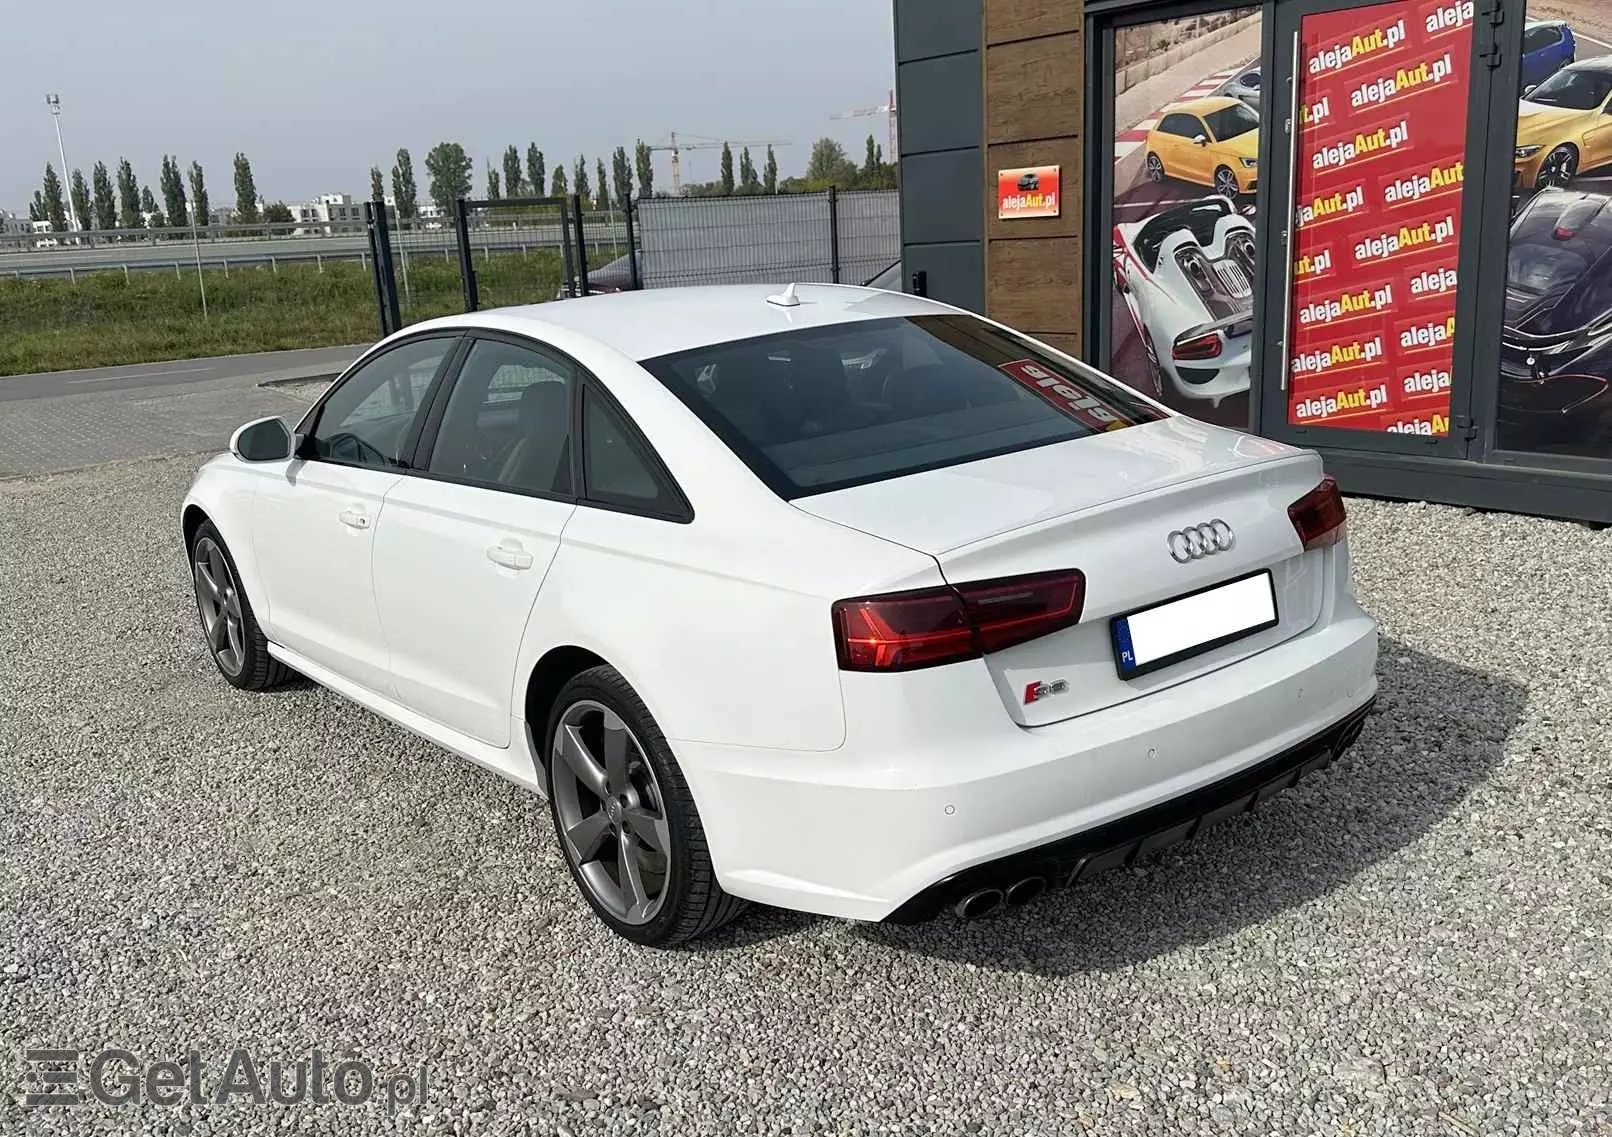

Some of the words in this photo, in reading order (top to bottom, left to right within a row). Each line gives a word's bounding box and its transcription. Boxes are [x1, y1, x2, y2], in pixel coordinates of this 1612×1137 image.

[1425, 0, 1474, 32] aleja
[1308, 19, 1406, 75] alejaAut.pl
[1351, 54, 1452, 107] alejaAut.pl
[1312, 120, 1409, 169] alejaAut.pl
[1384, 161, 1464, 202] alejaAut
[1002, 191, 1056, 211] alejaAut.pl
[1354, 216, 1454, 260] alejaAut.pl
[1410, 268, 1458, 294] aleja
[1300, 284, 1393, 324] alejaAut.pl
[1290, 337, 1383, 373] alejaAut.pl
[1403, 369, 1451, 393] aleja
[1296, 384, 1388, 418] alejaAut.pl
[1121, 650, 1134, 663] PL
